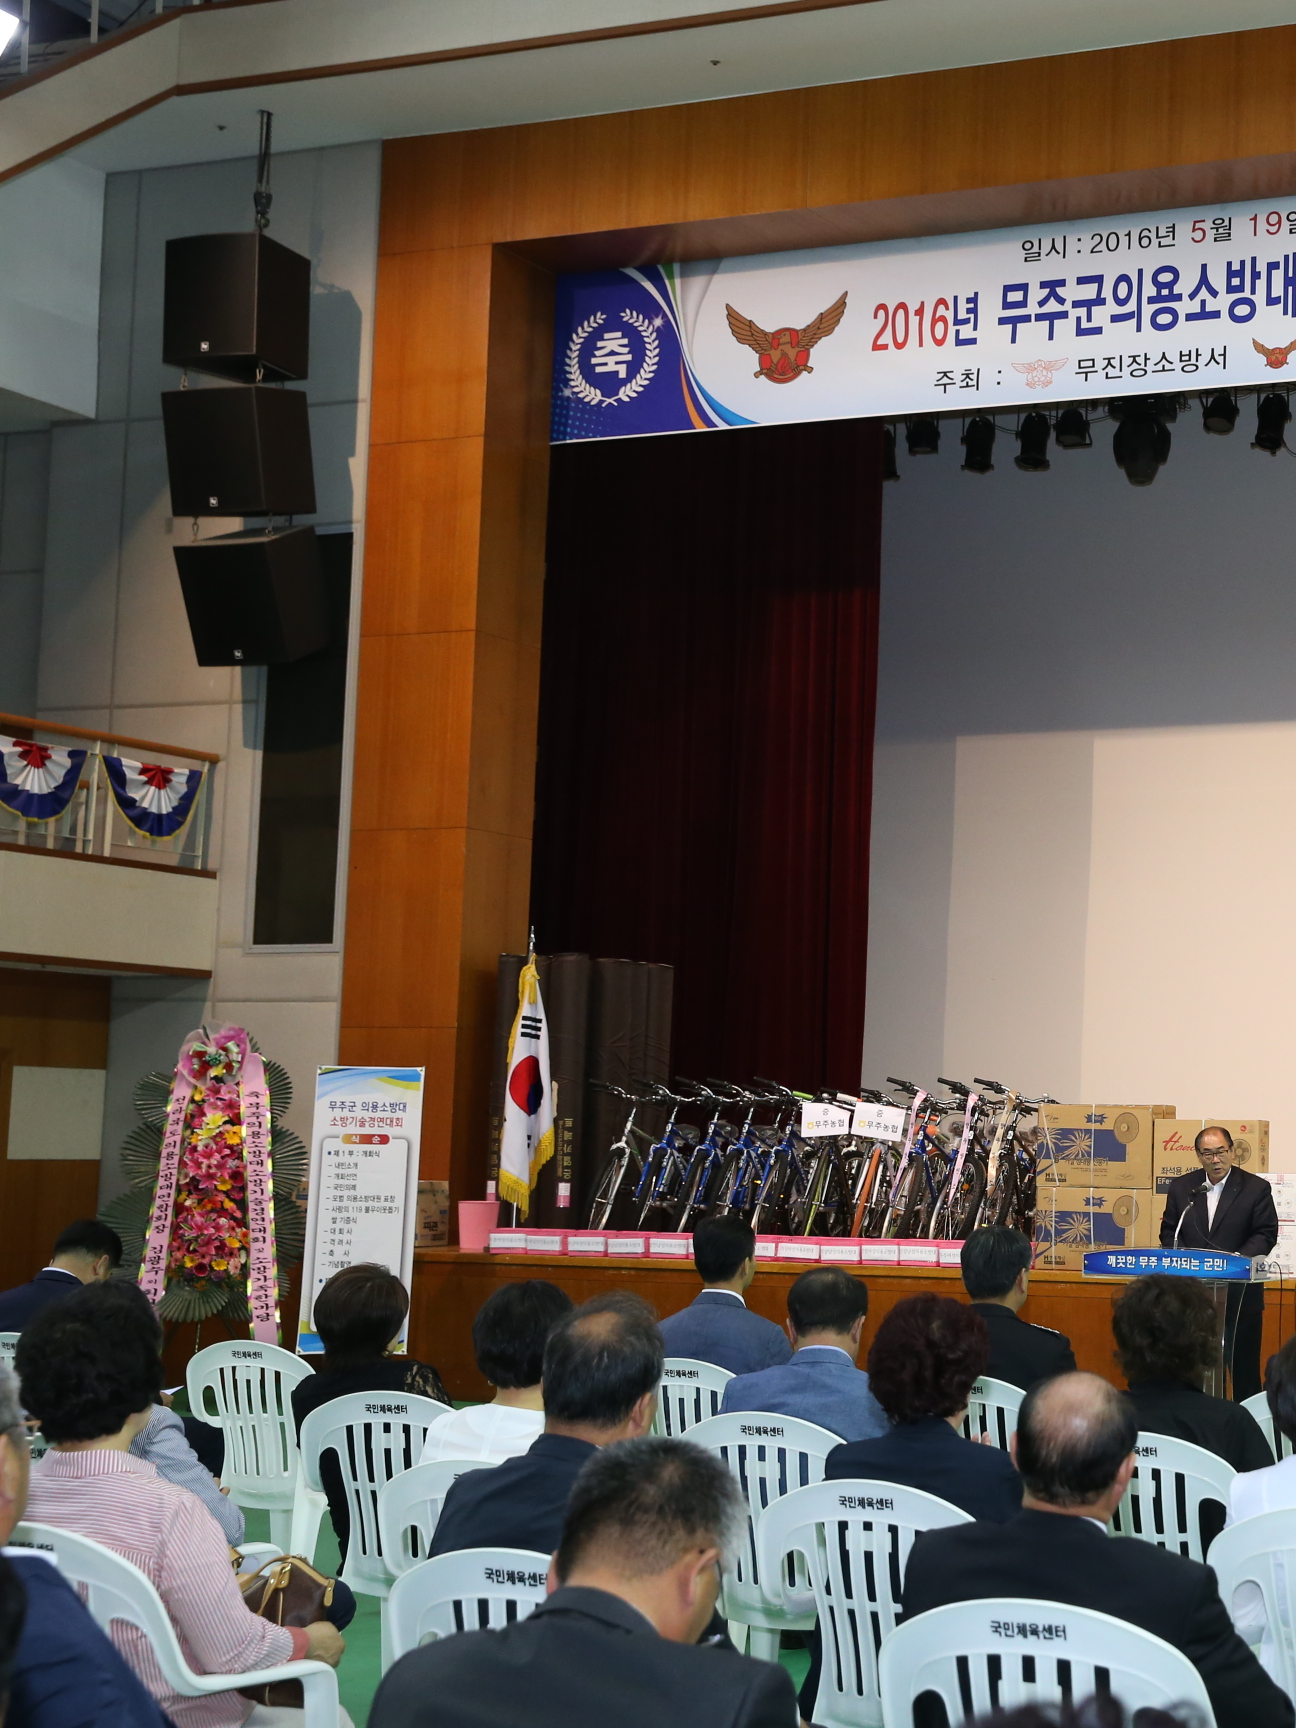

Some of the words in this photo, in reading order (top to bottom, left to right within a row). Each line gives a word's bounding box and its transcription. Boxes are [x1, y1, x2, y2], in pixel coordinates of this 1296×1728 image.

[1191, 217, 1233, 244] 5월
[871, 291, 980, 352] 2016년
[590, 331, 633, 379] 축
[934, 367, 981, 395] 주최
[1074, 345, 1228, 383] 무진장소방서
[328, 1101, 357, 1113] 무주군
[361, 1101, 408, 1114] 의용소방대
[330, 1116, 404, 1128] 소방기술경연대회
[362, 1150, 381, 1158] 개회식
[1107, 1255, 1137, 1269] 깨끗한
[1139, 1255, 1159, 1269] 무주
[1161, 1256, 1201, 1270] 부자되는
[1203, 1257, 1228, 1270] 군민!
[231, 1349, 263, 1361] 국민체육센터
[663, 1369, 699, 1379] 국민체육센터
[364, 1402, 408, 1415] 국민체육센터
[740, 1425, 785, 1438] 국민체육센터
[838, 1495, 894, 1511] 국민체육센터
[990, 1619, 1067, 1641] 국민체육센터
